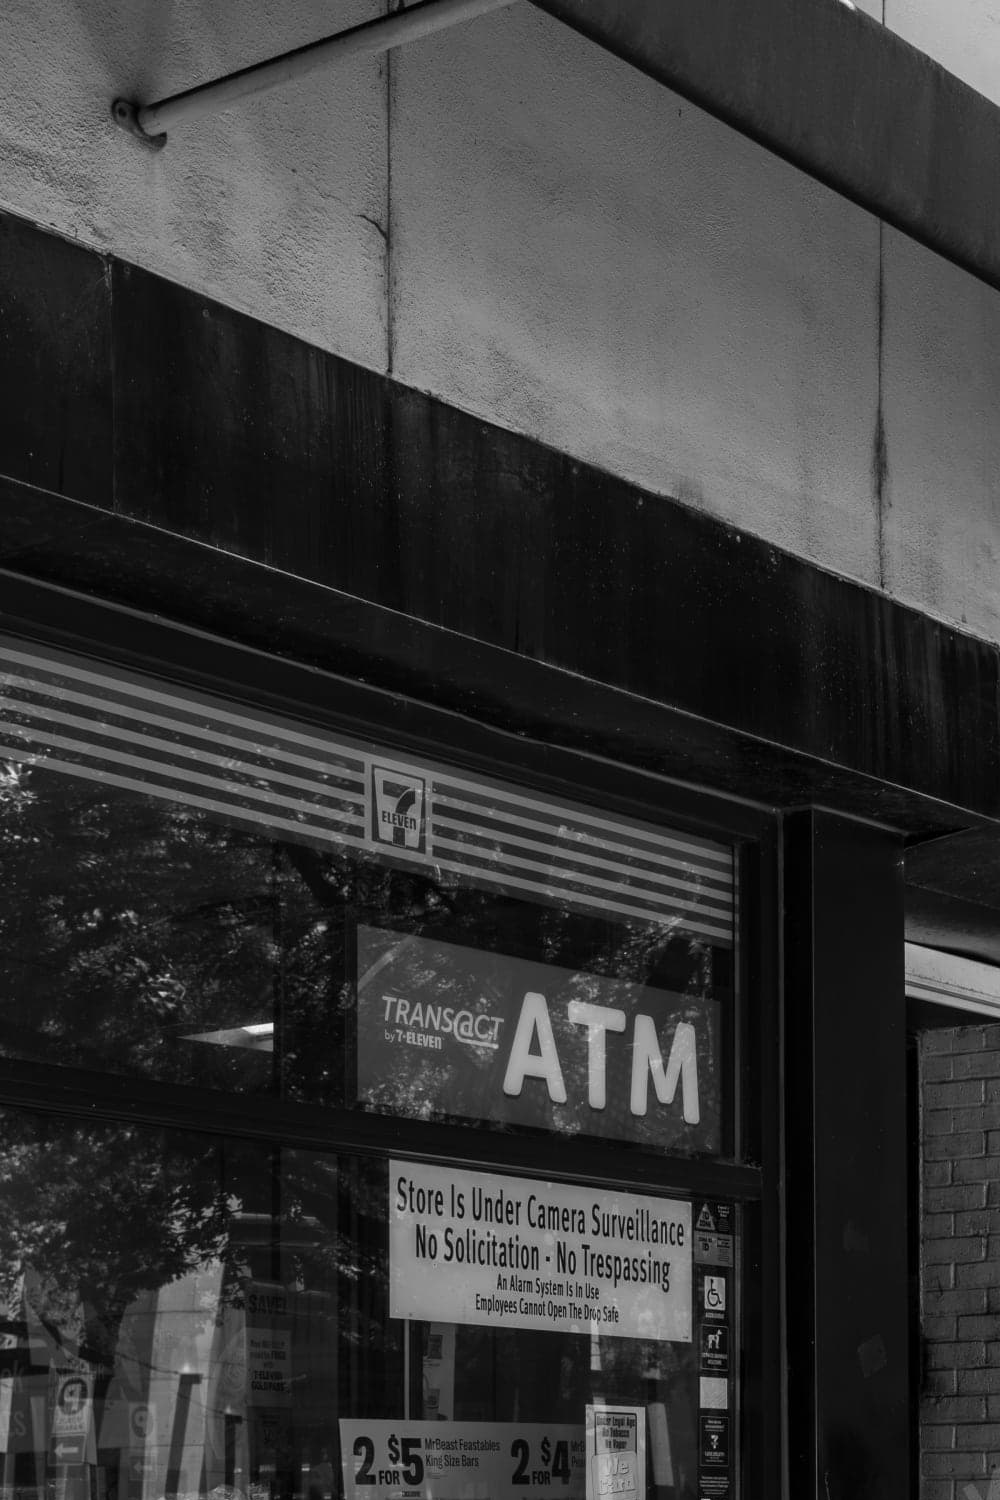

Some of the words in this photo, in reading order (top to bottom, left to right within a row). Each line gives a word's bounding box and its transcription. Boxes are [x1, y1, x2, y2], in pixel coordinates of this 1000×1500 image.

[384, 1030, 396, 1044] by
[503, 991, 700, 1125] ATM
[397, 1177, 444, 1217] Store
[451, 1184, 465, 1219] Is
[472, 1186, 521, 1226] Under
[527, 1194, 586, 1235] Camera
[591, 1203, 685, 1247] Surveillance
[415, 1223, 438, 1260] No
[444, 1227, 540, 1271] Solicitation
[545, 1255, 551, 1263] -
[557, 1241, 577, 1276] No
[581, 1244, 671, 1293] Trespassing
[497, 1274, 508, 1291] An
[510, 1277, 533, 1294] Alarm
[536, 1278, 564, 1299] System
[566, 1282, 573, 1297] Is
[576, 1283, 583, 1298] In
[586, 1284, 600, 1300] Use
[476, 1294, 518, 1317] Employees
[520, 1298, 546, 1317] Cannot
[548, 1302, 567, 1321] Open
[569, 1303, 583, 1320] The
[584, 1304, 601, 1323] Drop
[603, 1305, 619, 1323] Safe
[353, 1436, 376, 1485] 2
[387, 1433, 425, 1486] $5
[425, 1439, 458, 1451] MrBeast
[458, 1438, 500, 1452] Feastables
[425, 1453, 443, 1470] King
[444, 1454, 460, 1468] Size
[462, 1456, 480, 1468] Bars
[511, 1438, 531, 1485] 2
[540, 1436, 571, 1486] $4
[379, 1469, 400, 1486] FOR
[532, 1470, 550, 1486] FOR
